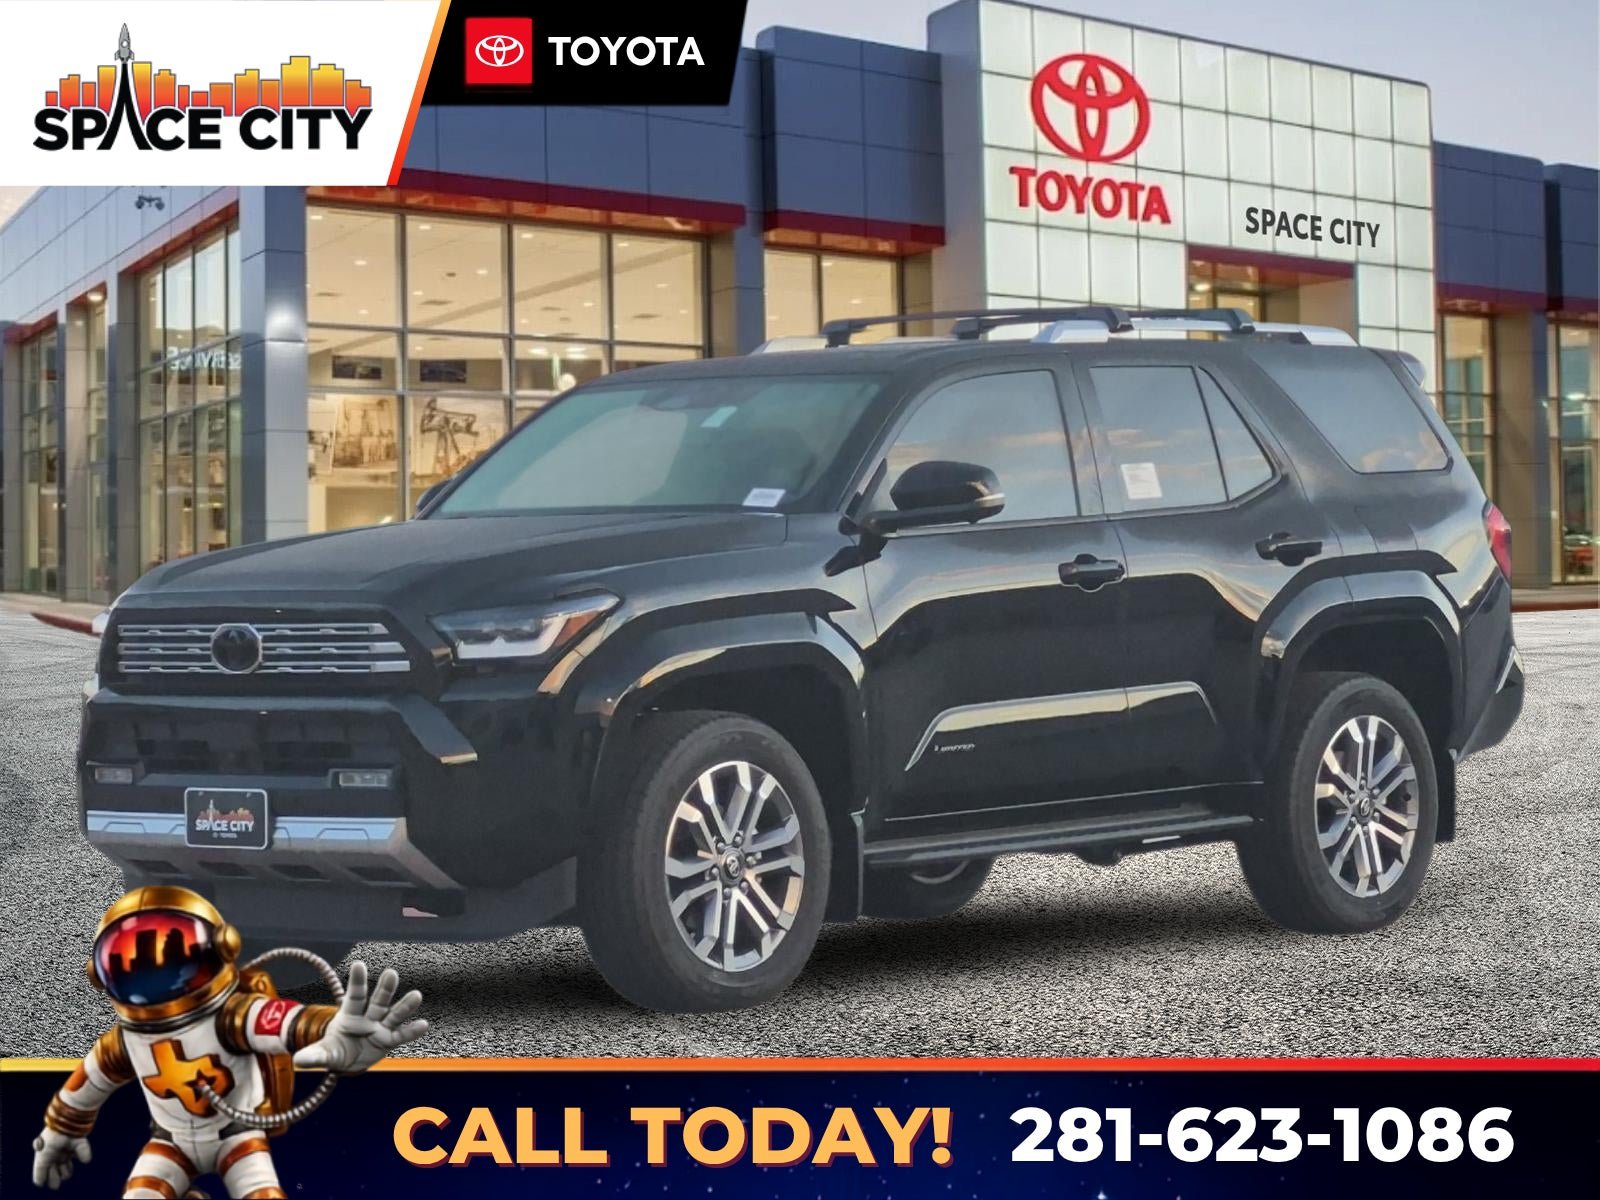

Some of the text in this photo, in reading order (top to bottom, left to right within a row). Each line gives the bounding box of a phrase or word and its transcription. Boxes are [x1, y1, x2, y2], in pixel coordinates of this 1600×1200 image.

[1009, 165, 1171, 225] TOYOTA
[1245, 206, 1381, 248] SPACE CITY
[195, 819, 254, 832] SPACE CITY
